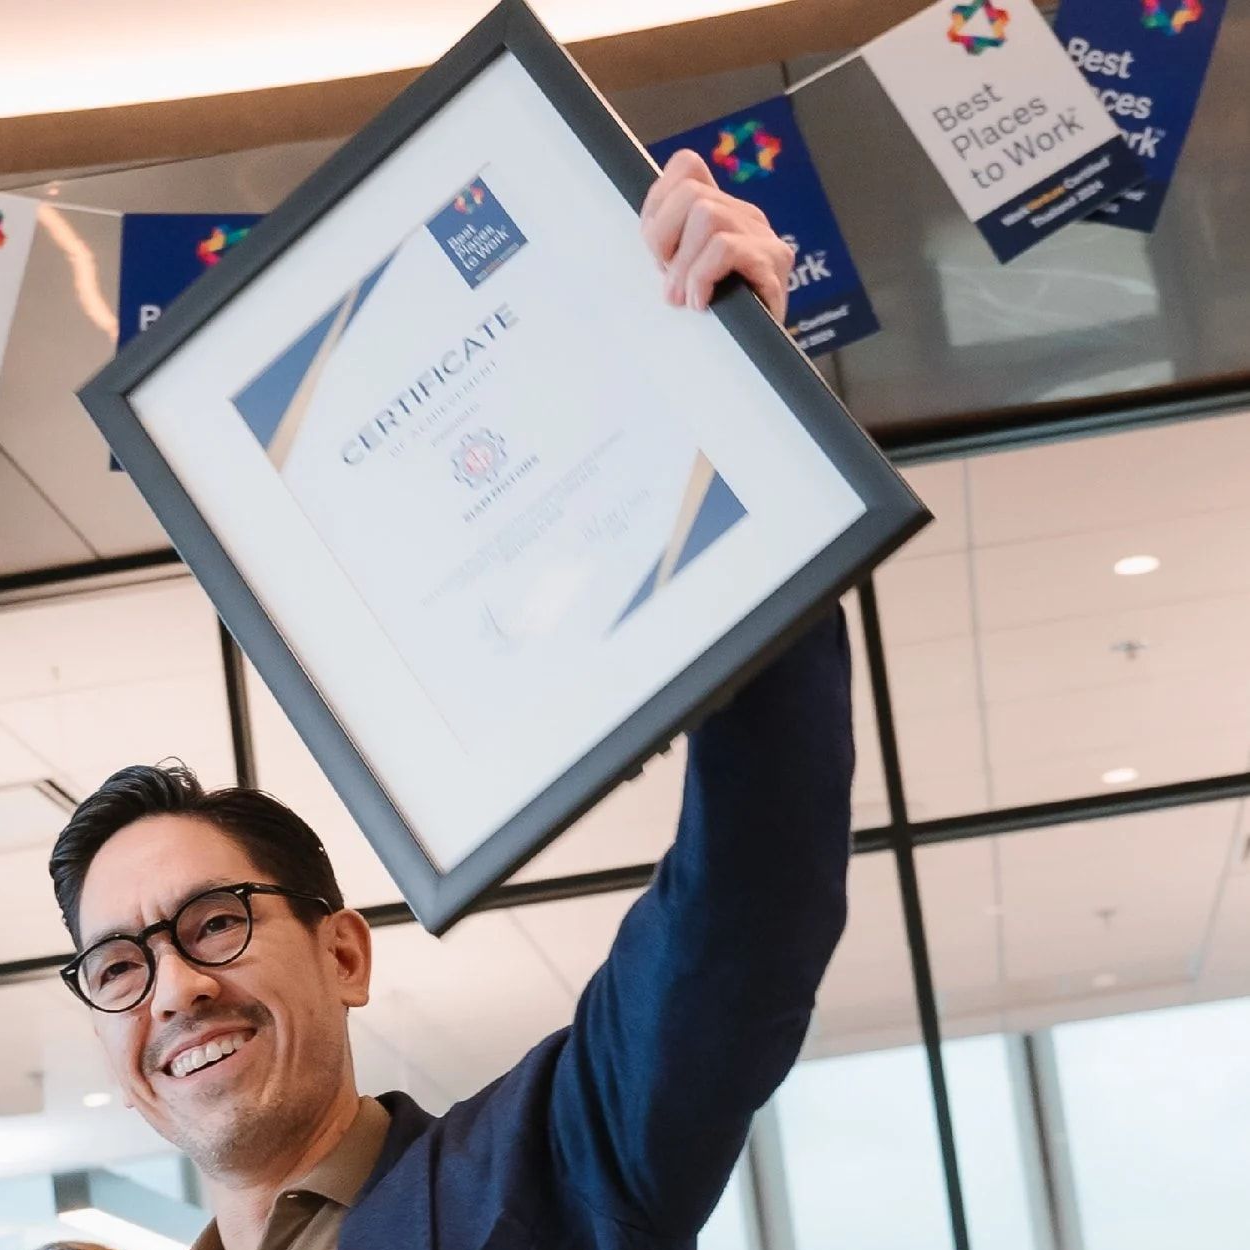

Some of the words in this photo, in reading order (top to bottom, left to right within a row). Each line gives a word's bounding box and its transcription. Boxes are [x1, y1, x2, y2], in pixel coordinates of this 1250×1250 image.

[933, 84, 1003, 132] Best
[1093, 86, 1153, 119] ces
[951, 97, 1048, 160] Places
[971, 160, 1004, 188] to
[340, 302, 519, 467] CERTIFICATE
